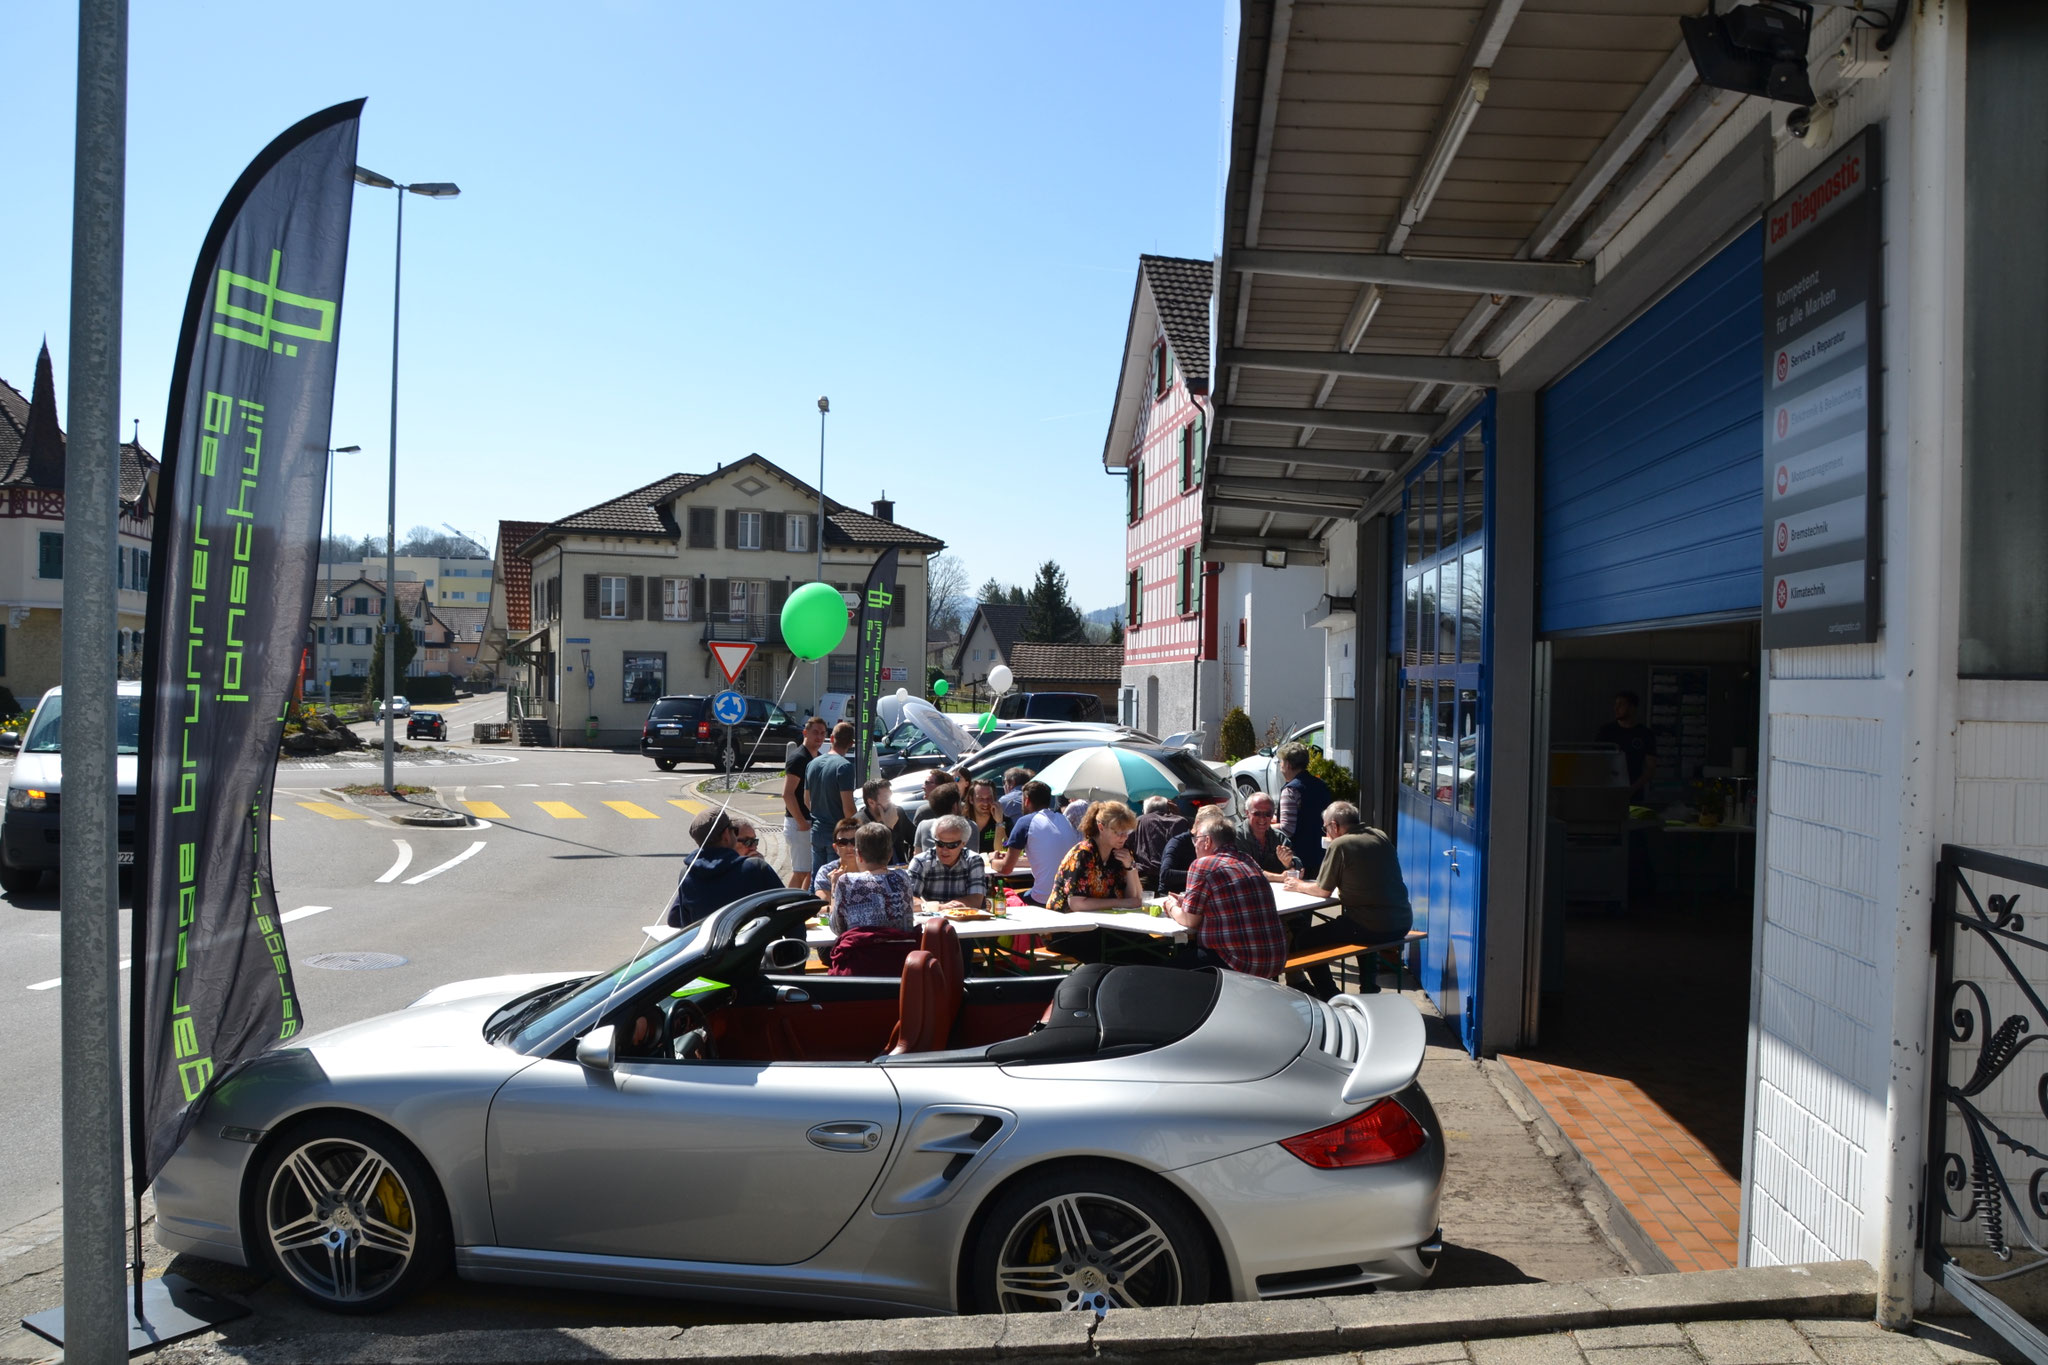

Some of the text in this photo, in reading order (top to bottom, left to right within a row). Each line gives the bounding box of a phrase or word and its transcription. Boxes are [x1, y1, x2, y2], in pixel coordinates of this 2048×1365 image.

[1770, 156, 1860, 244] Car Diagnostic
[1776, 270, 1820, 308] Kompetenz
[1776, 288, 1837, 335] für alle Marken
[1790, 347, 1811, 368] Service
[1816, 330, 1847, 355] Reparatur
[215, 399, 265, 703] jonschwil
[1790, 521, 1829, 542] Bremstechnik
[173, 504, 211, 815] brunner
[200, 391, 233, 477] ag
[1790, 582, 1826, 599] Klimatechnik
